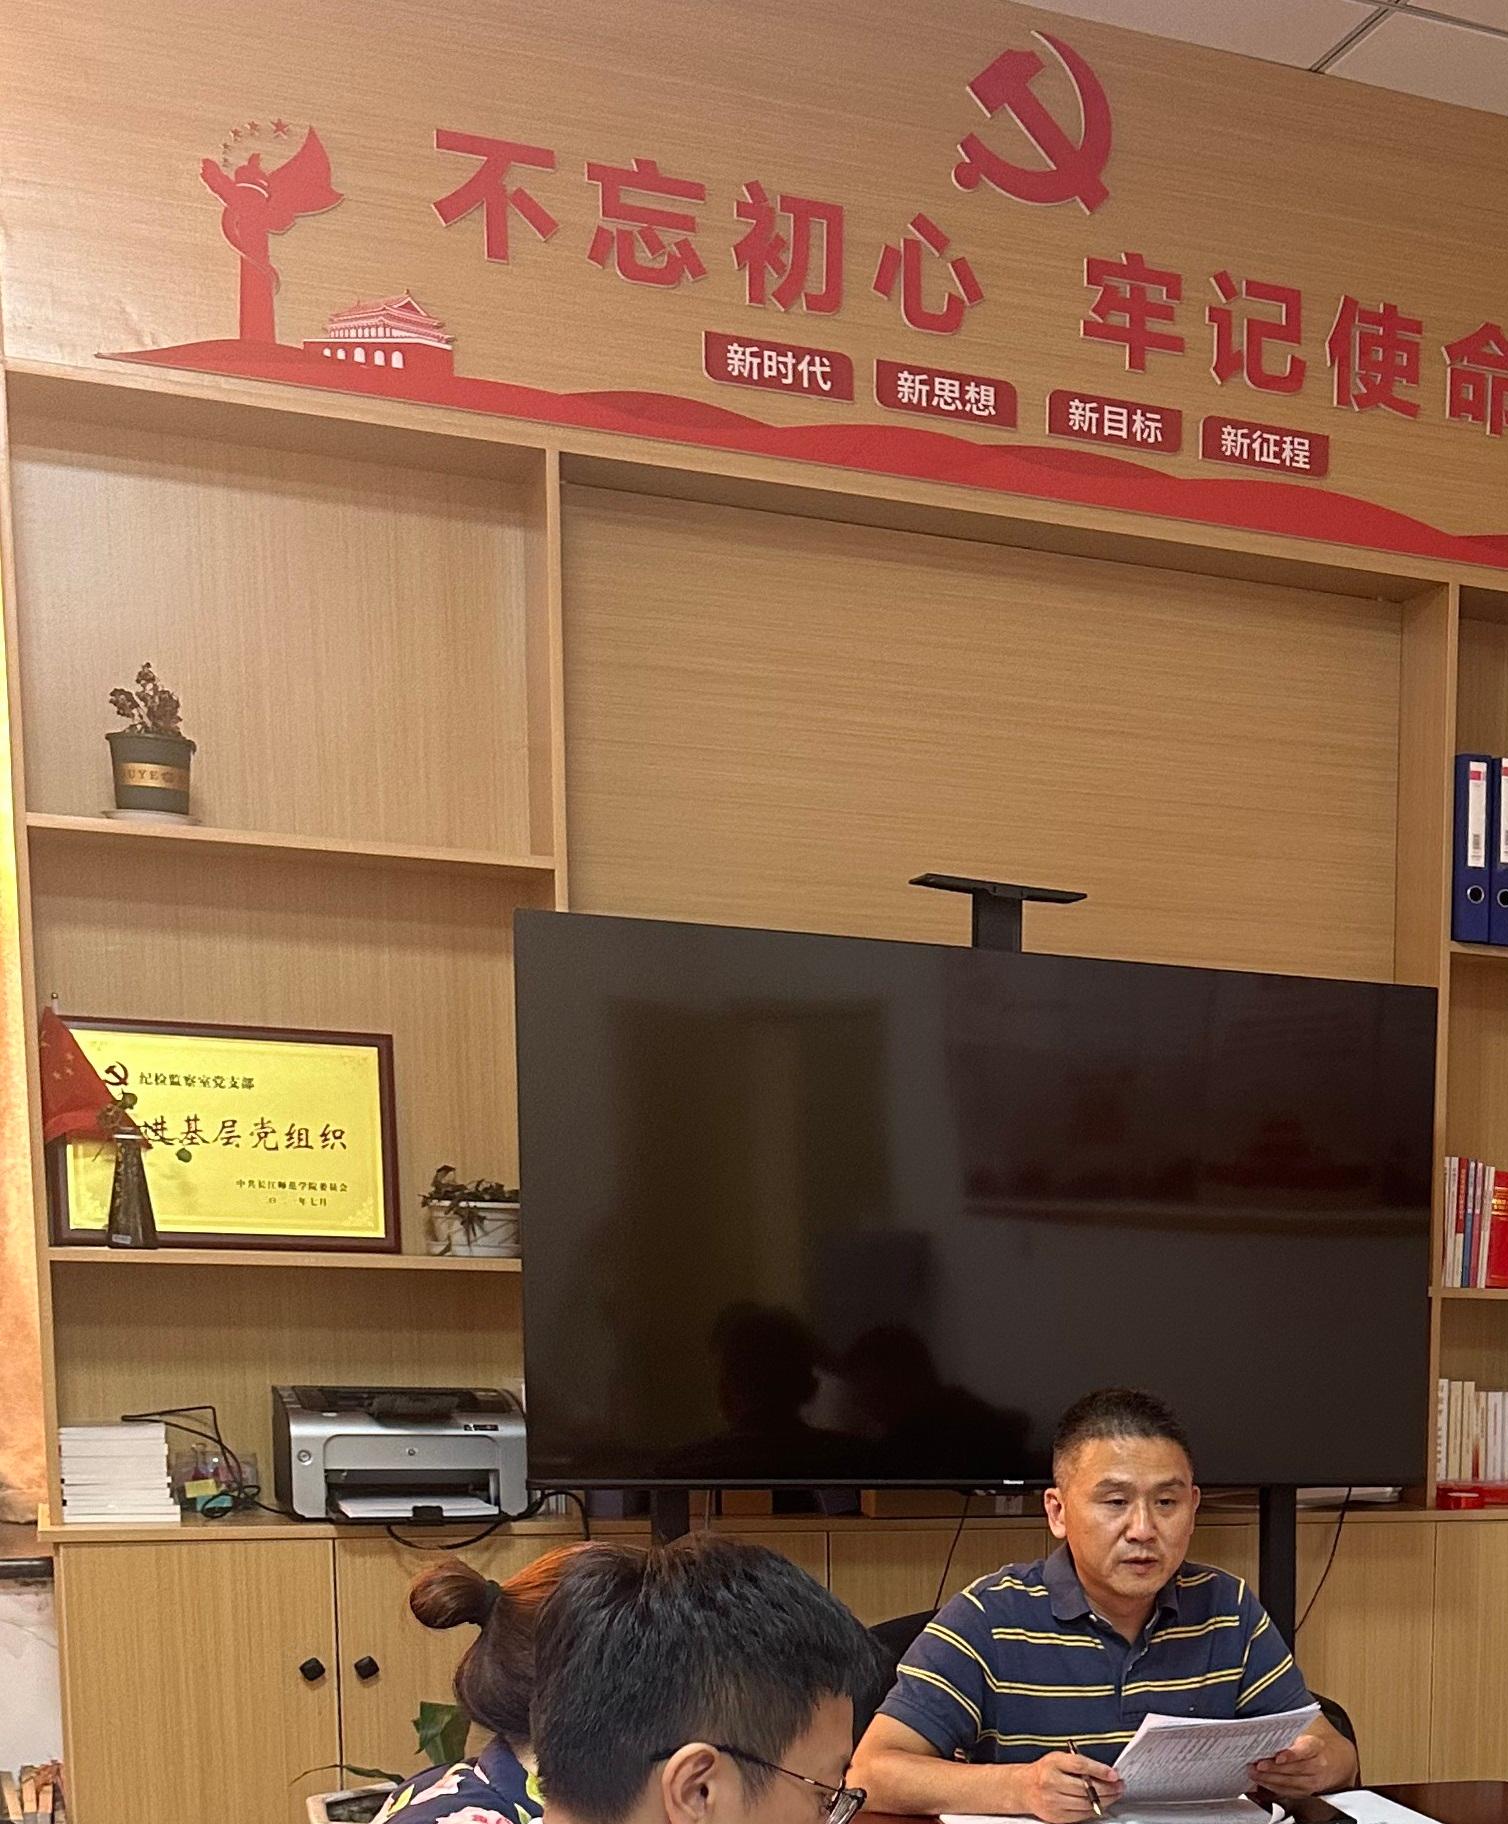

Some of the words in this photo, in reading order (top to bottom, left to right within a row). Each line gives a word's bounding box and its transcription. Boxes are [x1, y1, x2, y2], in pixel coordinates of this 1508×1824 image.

[432, 126, 984, 335] 不忘初心
[725, 343, 833, 392] 新时代
[897, 370, 997, 417] 新思想
[1068, 398, 1164, 445] 新目标
[1220, 426, 1311, 470] 新征程
[139, 1071, 255, 1091] 纪检监察室党支部
